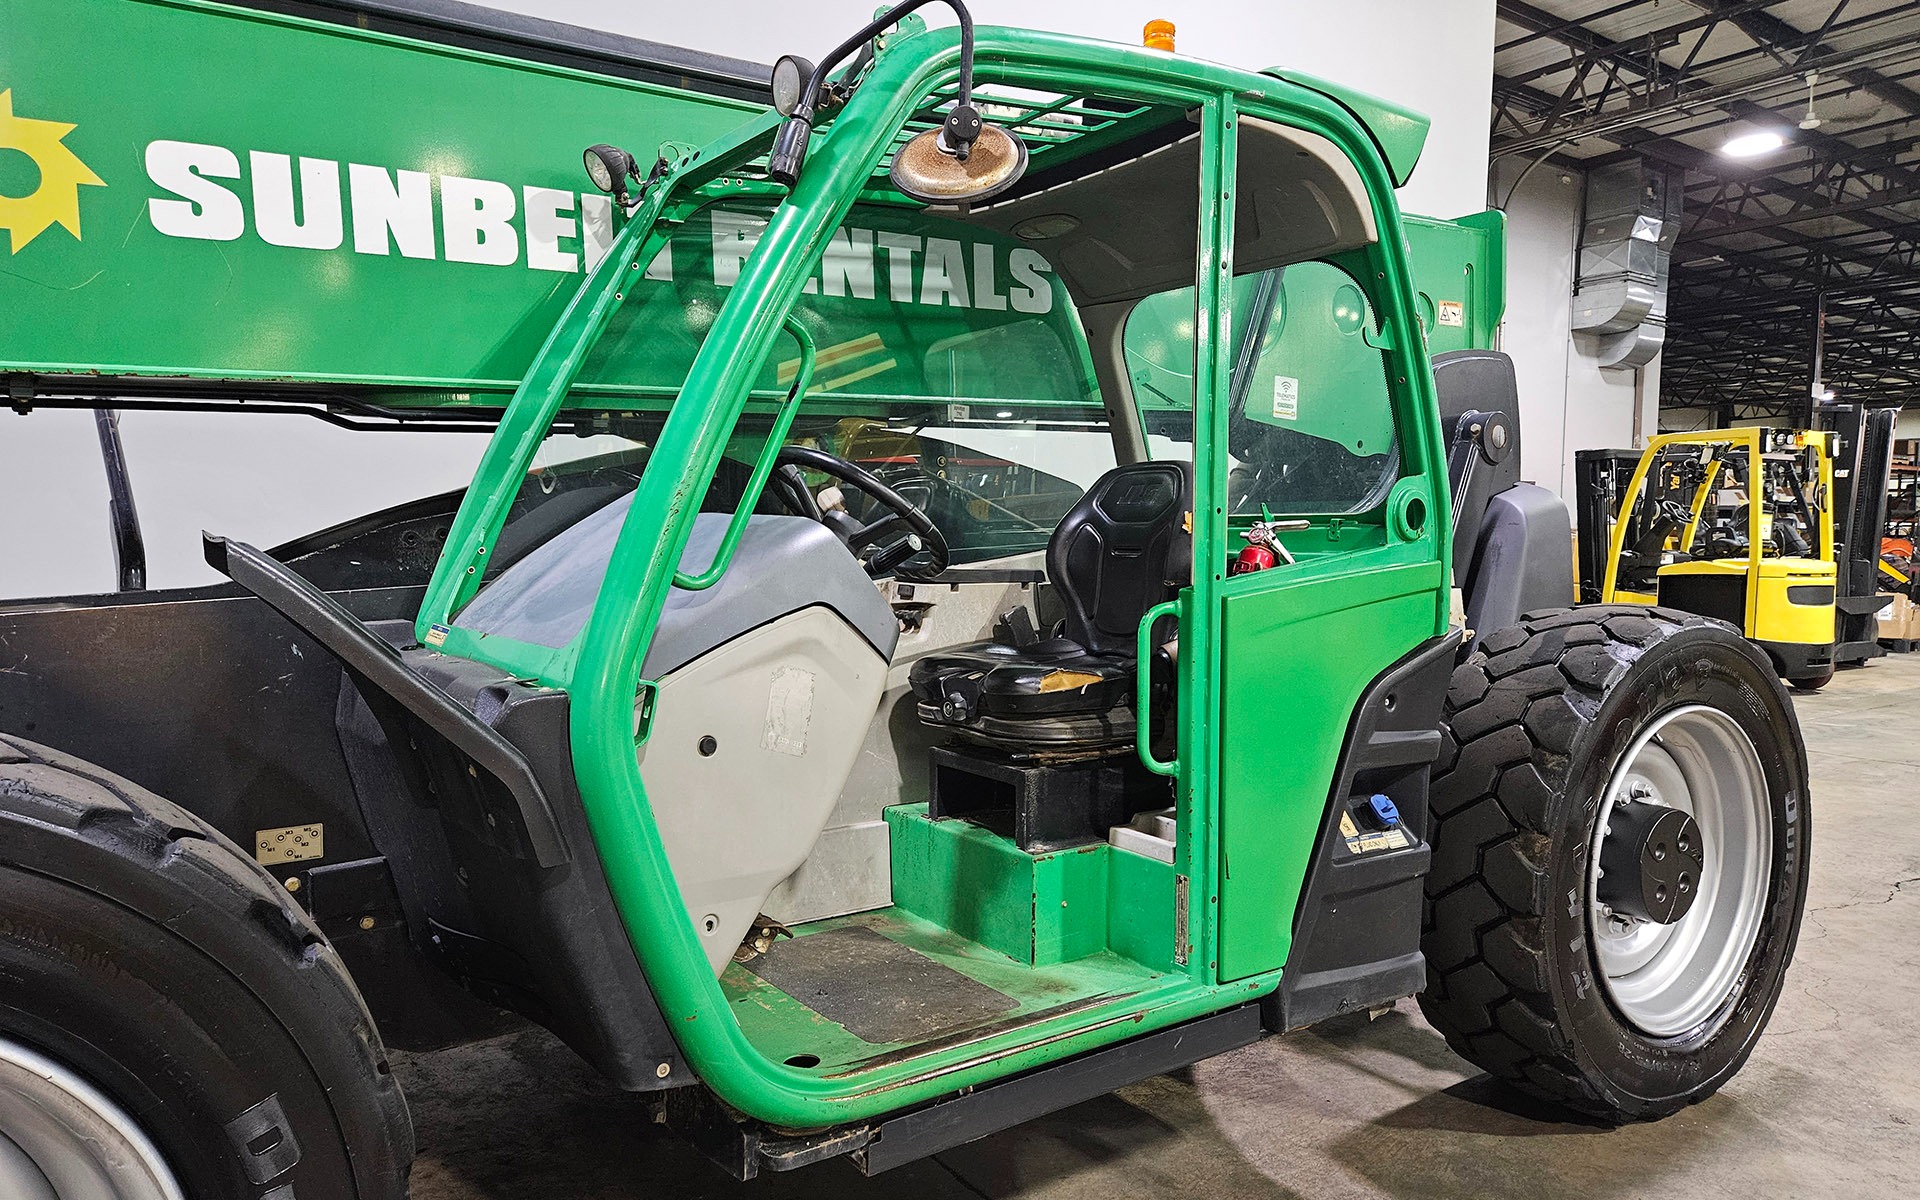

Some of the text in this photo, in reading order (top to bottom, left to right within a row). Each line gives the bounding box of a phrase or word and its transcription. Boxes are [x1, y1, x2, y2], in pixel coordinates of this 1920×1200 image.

[144, 139, 1053, 315] SUNBEL RNTALS
[1834, 469, 1850, 478] CAT
